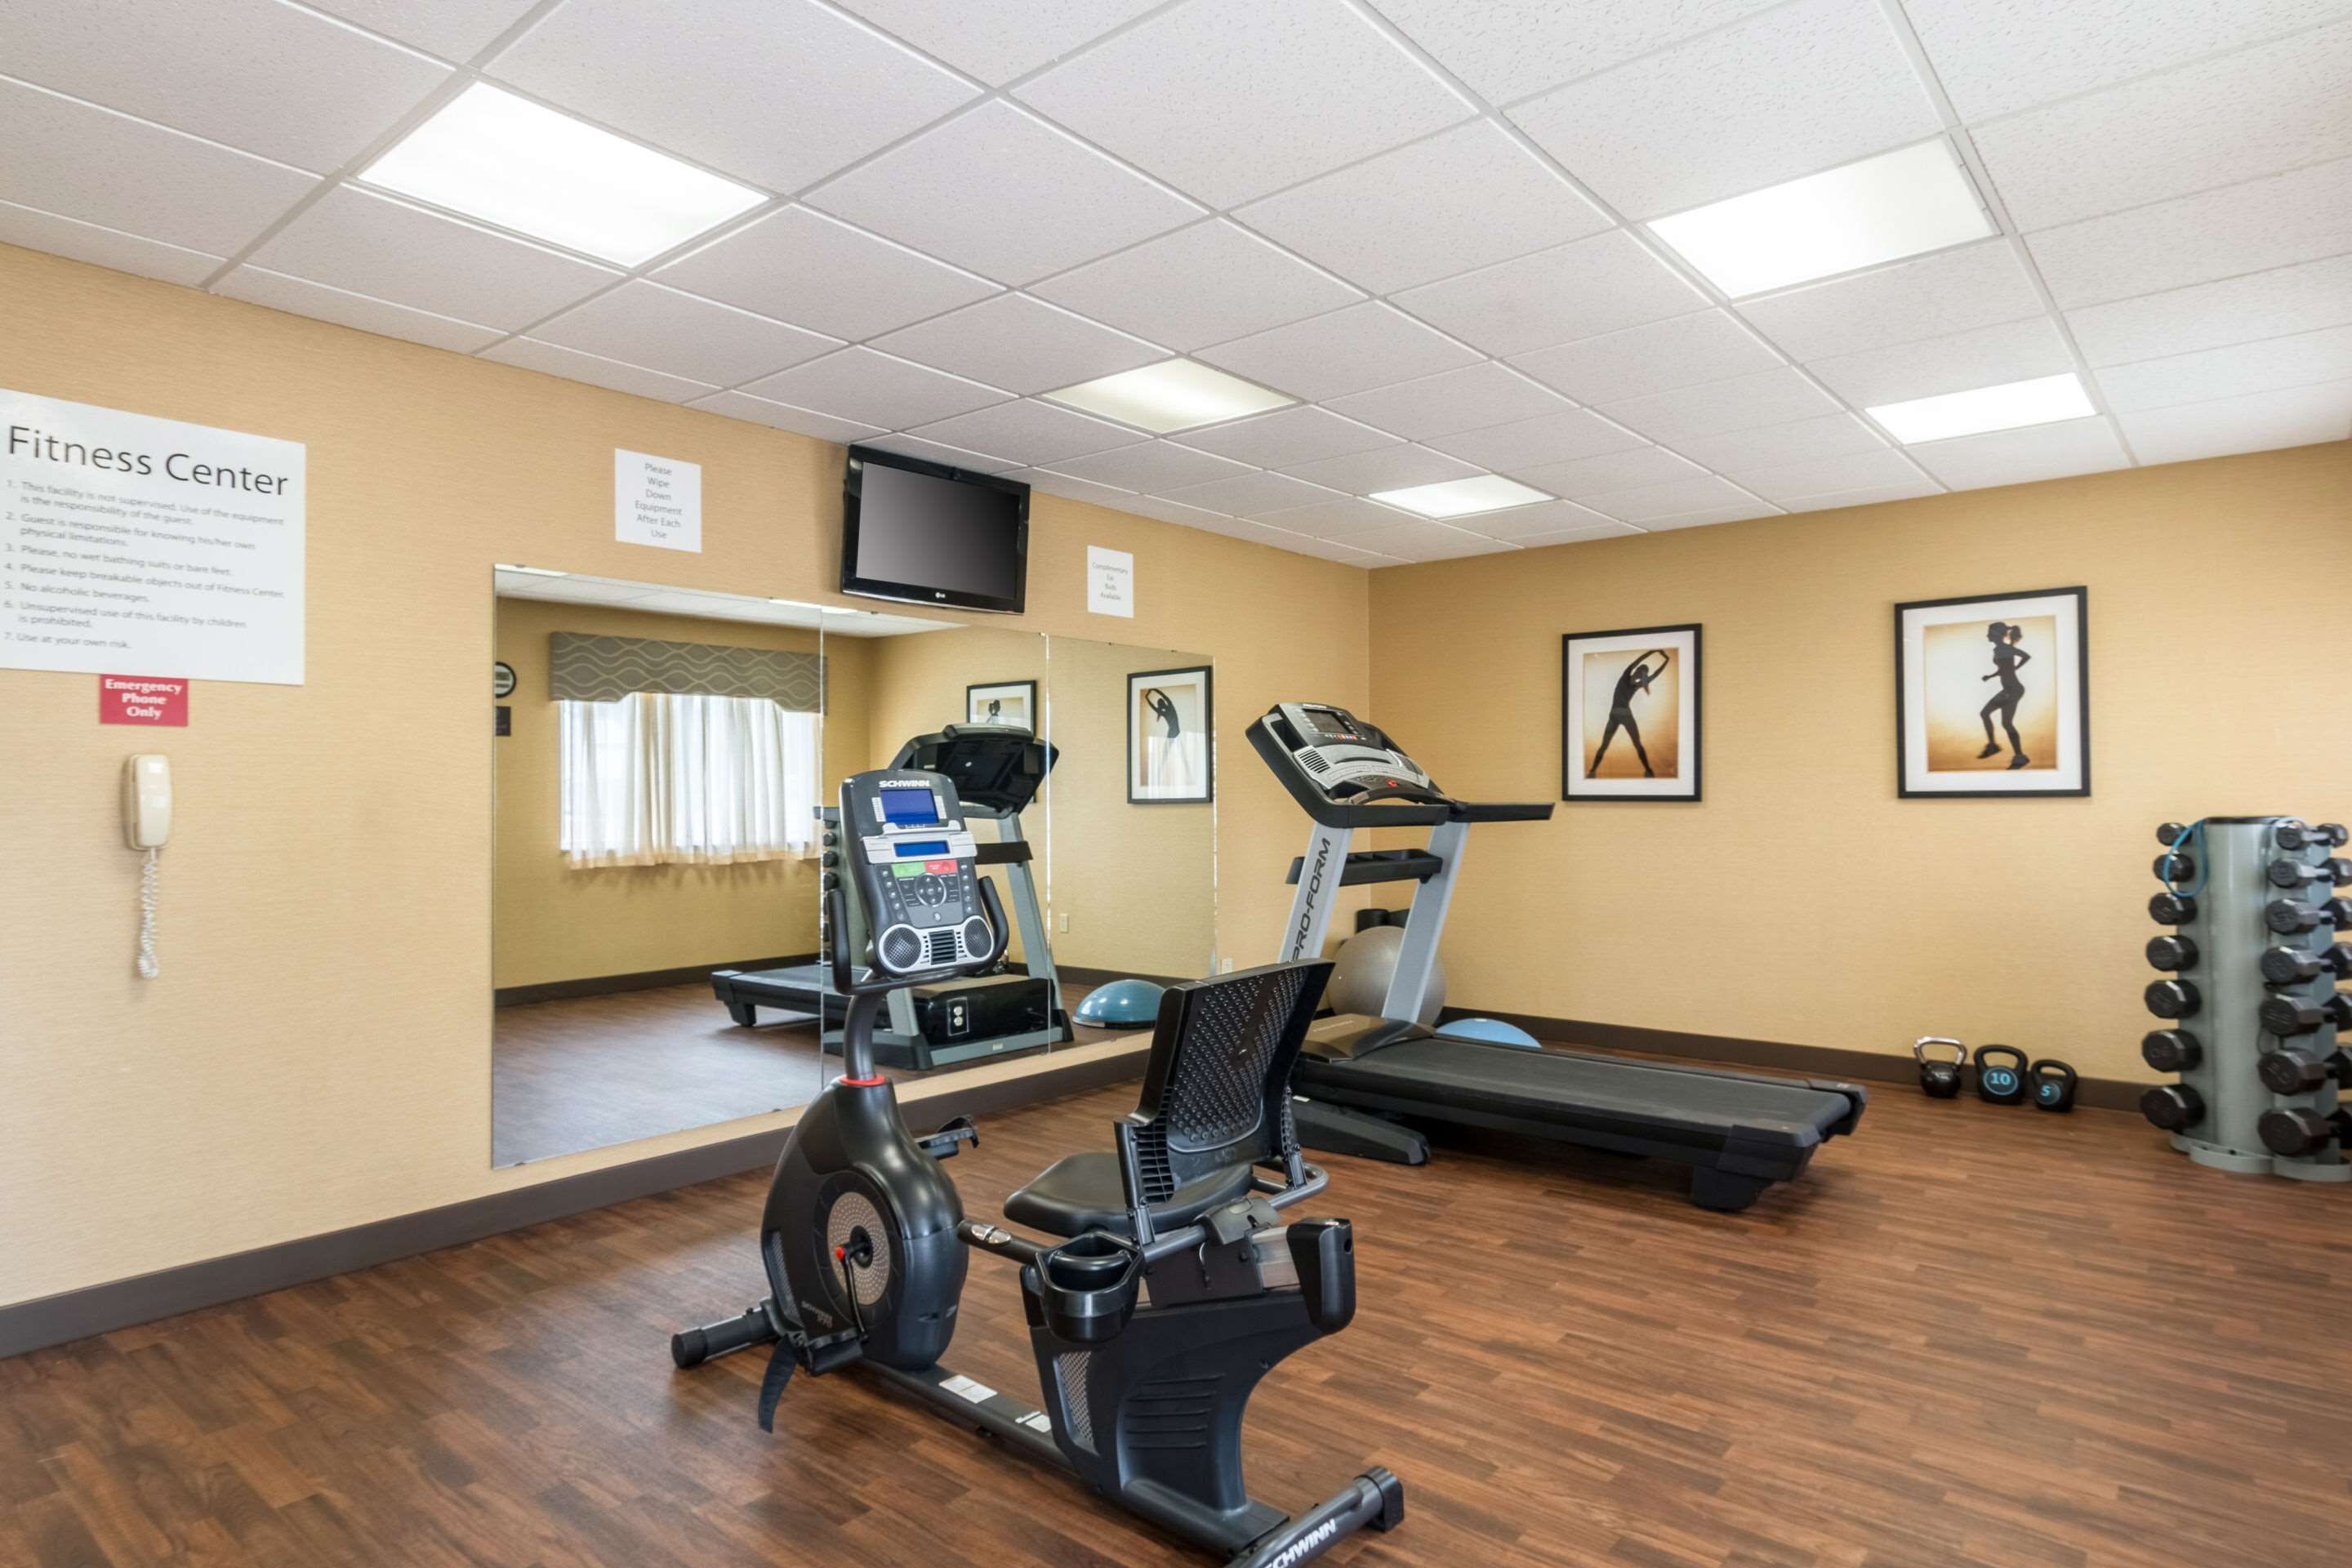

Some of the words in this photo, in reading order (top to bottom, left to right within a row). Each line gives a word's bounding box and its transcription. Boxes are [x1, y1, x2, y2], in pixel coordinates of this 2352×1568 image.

[8, 424, 154, 476] Fitness
[165, 452, 289, 497] Center
[644, 462, 672, 475] Please
[647, 476, 670, 488] Wipe
[645, 489, 671, 501] Down
[20, 480, 44, 492] This
[47, 485, 82, 498] facility
[98, 493, 116, 502] not
[180, 504, 198, 514] Use
[213, 509, 229, 519] the
[232, 513, 284, 527] equipment
[20, 496, 29, 504] is
[33, 497, 51, 506] the
[54, 501, 127, 518] responsibility
[130, 510, 142, 519] of
[143, 511, 160, 521] the
[635, 500, 682, 516] Equipment
[636, 514, 658, 524] After
[660, 517, 681, 528] Each
[20, 513, 55, 525] Guest
[69, 521, 131, 534] responsible
[134, 528, 148, 537] for
[151, 531, 195, 545] knowing
[234, 541, 256, 550] own
[20, 527, 66, 540] physical
[650, 529, 667, 539] Use
[63, 551, 78, 559] no
[81, 554, 100, 563] wet
[103, 557, 145, 570] bathing
[148, 560, 171, 569] suits
[186, 564, 209, 573] bare
[20, 563, 57, 576] Please
[60, 568, 87, 581] keep
[90, 572, 143, 585] breakable
[145, 577, 183, 590] objects
[185, 581, 203, 590] out
[204, 582, 216, 591] of
[217, 585, 251, 595] Fitness
[21, 581, 38, 592] No
[41, 586, 91, 598] alcoholic
[20, 601, 98, 617] Unsupervised
[101, 610, 119, 618] use
[122, 610, 134, 619] of
[135, 611, 154, 621] this
[156, 612, 189, 625] facility
[191, 617, 205, 626] by
[207, 617, 247, 629] children
[16, 632, 38, 642] Use
[42, 635, 52, 644] at
[56, 637, 81, 647] your
[82, 639, 107, 648] own
[105, 678, 184, 696] Emergency
[122, 692, 168, 705] Phone
[126, 706, 163, 720] Only
[879, 779, 931, 788] SCHWINN
[1990, 1072, 2011, 1085] 10
[2041, 1085, 2051, 1097] 5
